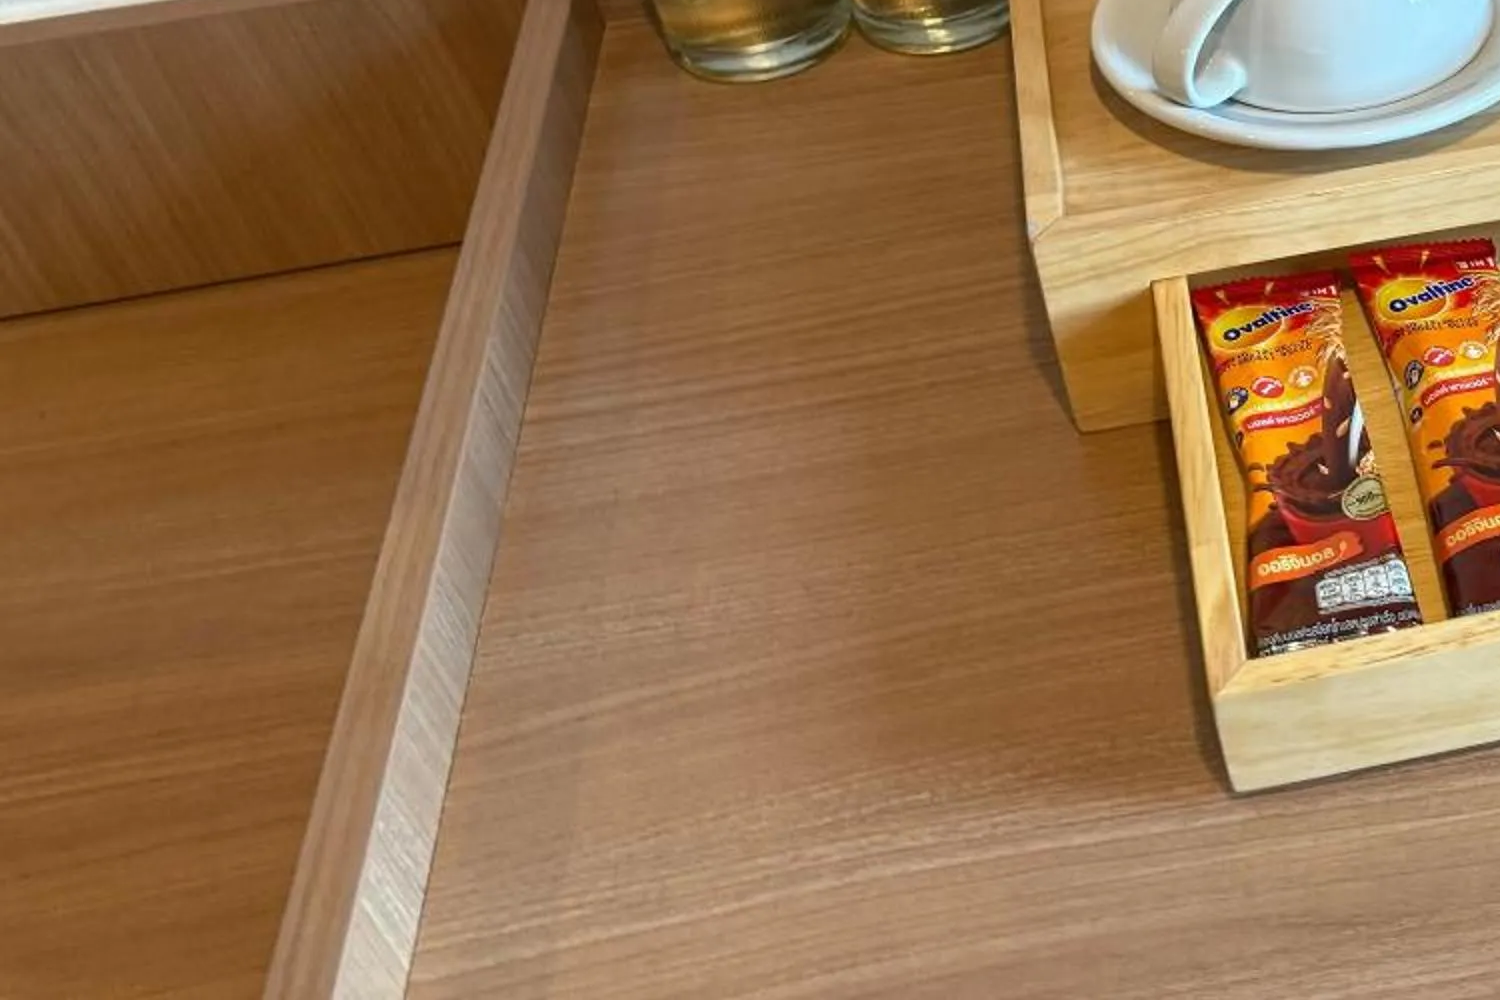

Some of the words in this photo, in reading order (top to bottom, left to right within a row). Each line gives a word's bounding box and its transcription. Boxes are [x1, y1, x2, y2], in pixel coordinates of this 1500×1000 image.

[1388, 277, 1476, 313] Ovaltine
[1222, 301, 1315, 342] Ovaltine
[1257, 547, 1336, 577] ออริจินอล
